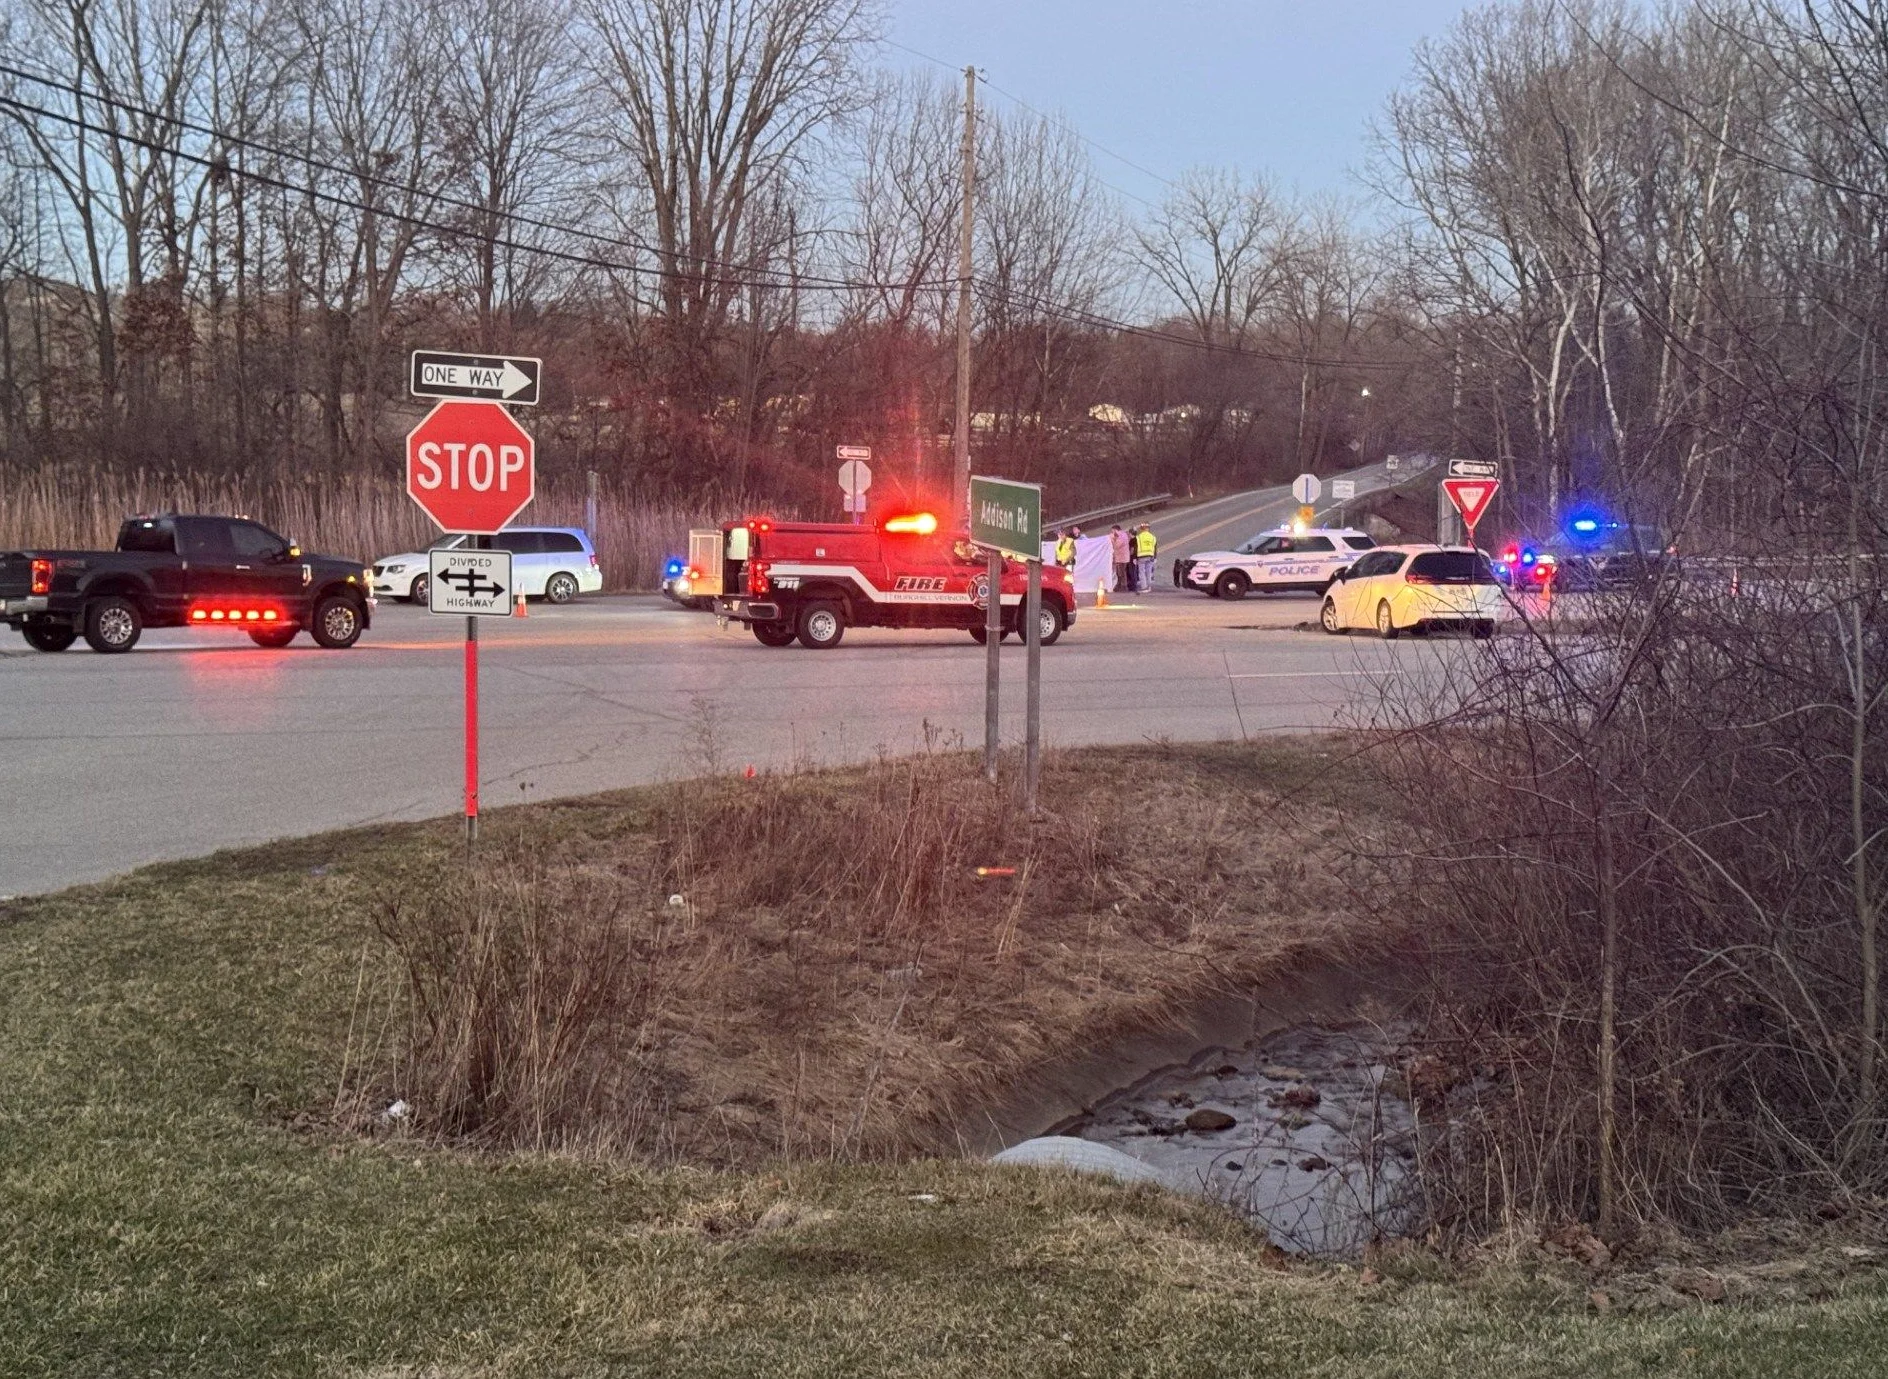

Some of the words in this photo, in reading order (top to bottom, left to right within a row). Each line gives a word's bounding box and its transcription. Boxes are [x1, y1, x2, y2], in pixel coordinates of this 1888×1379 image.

[424, 365, 457, 384] ONE
[469, 368, 504, 387] WAY
[417, 441, 524, 492] STOP
[980, 500, 1014, 531] Addison
[1017, 506, 1028, 534] Rd
[449, 557, 492, 567] DIVIDED
[1269, 565, 1320, 576] POLICE
[894, 576, 947, 591] FIRE
[446, 597, 495, 608] HIGHWAY
